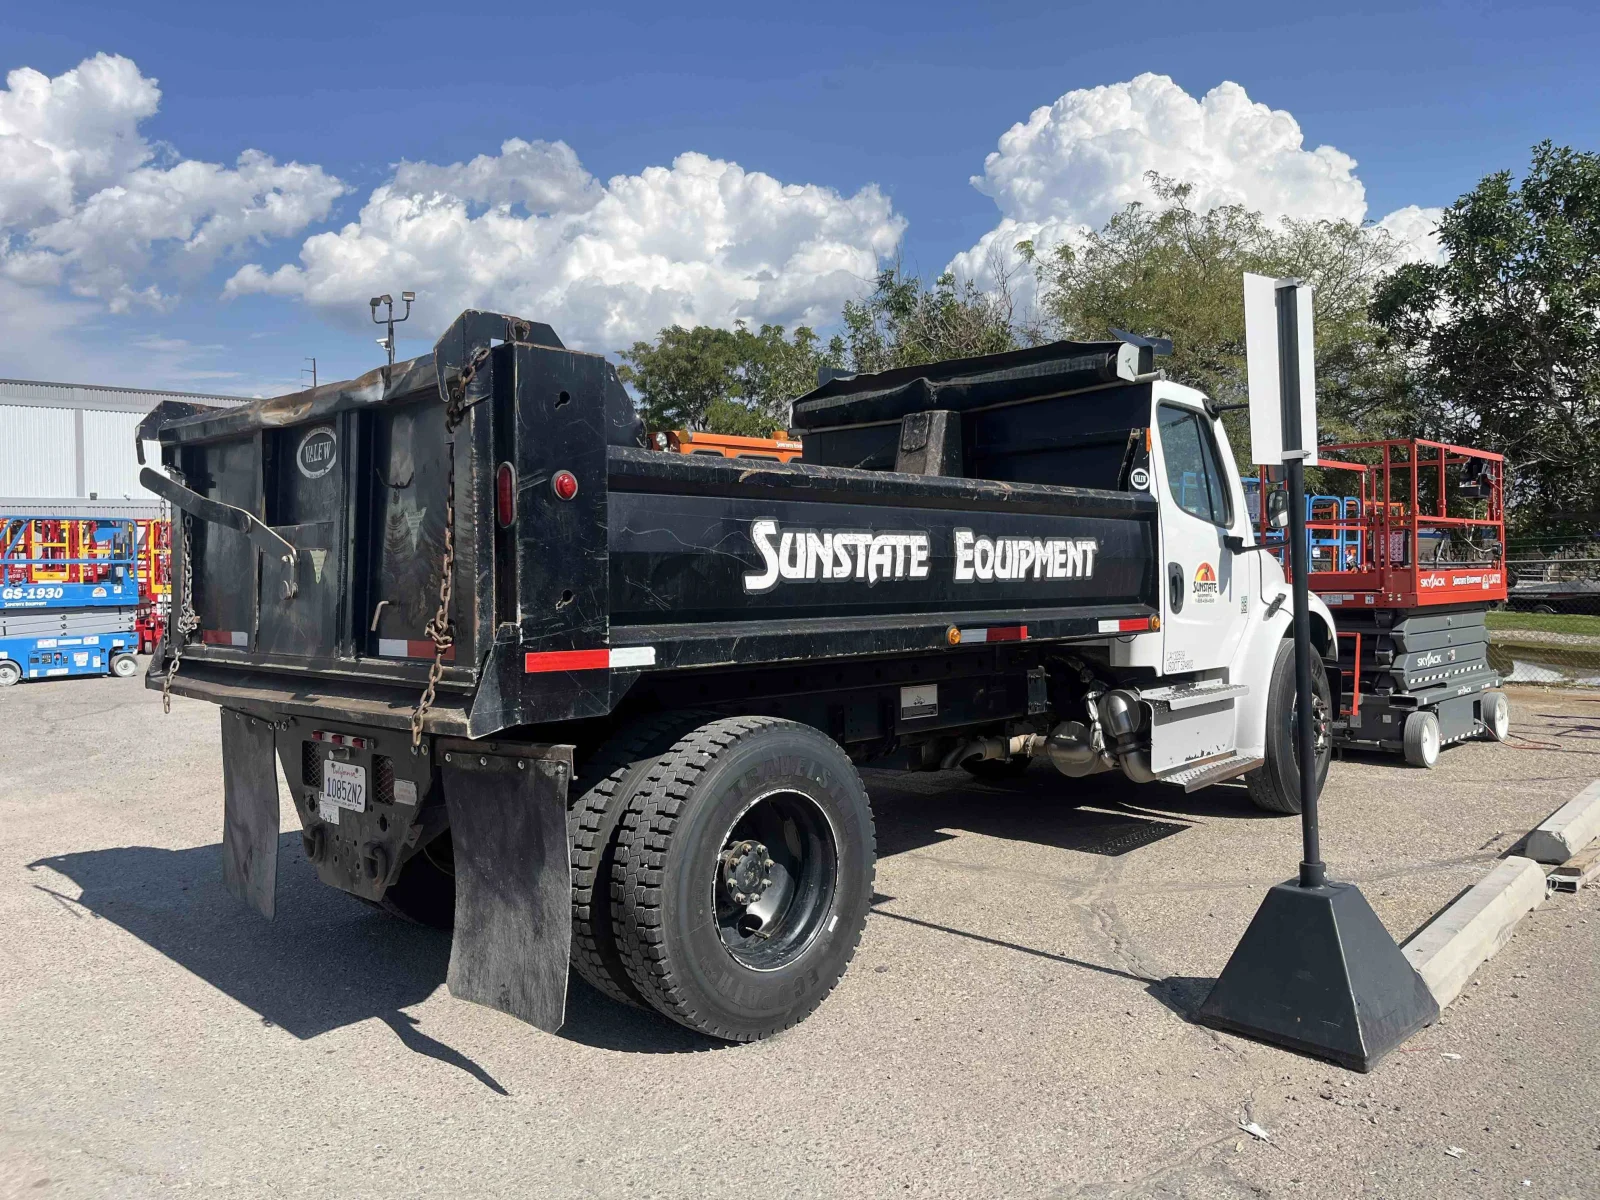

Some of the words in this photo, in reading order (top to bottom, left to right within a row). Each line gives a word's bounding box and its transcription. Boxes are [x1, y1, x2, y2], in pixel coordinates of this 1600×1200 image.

[305, 441, 332, 463] VALEW
[744, 520, 929, 591] SUNSTATE
[953, 530, 1097, 580] EQUIPMENT
[1192, 581, 1217, 593] SUNSTATE
[1420, 573, 1445, 588] SKYJACK
[2, 587, 63, 599] GS-1930
[1417, 651, 1441, 667] SKYJACK
[326, 777, 363, 806] 10852N2
